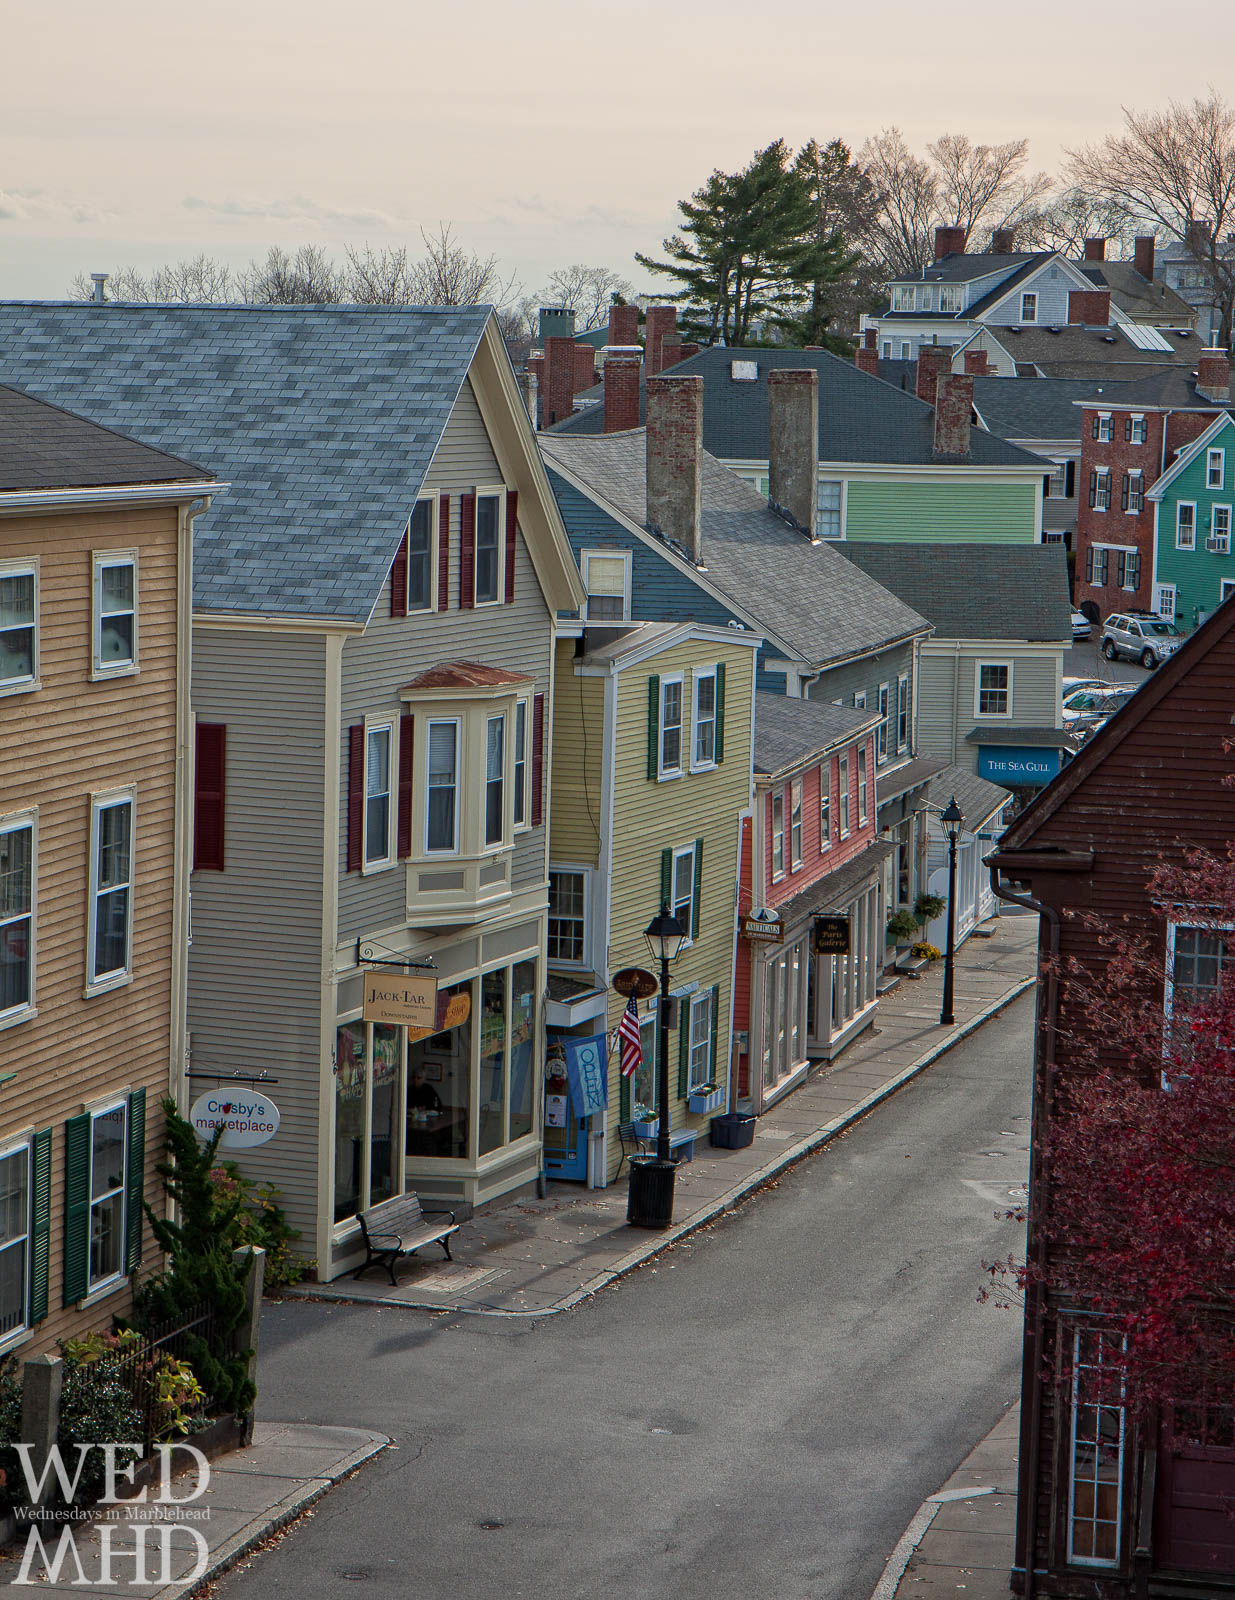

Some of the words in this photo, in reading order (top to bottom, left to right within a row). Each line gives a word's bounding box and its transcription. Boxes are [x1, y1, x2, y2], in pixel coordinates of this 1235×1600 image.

[988, 760, 1006, 770] THE
[1008, 761, 1025, 771] SEA
[1026, 762, 1050, 772] GULL
[747, 922, 779, 933] NAUTICALS
[368, 989, 425, 1004] JACK-TAR
[581, 1049, 600, 1109] OPEN
[195, 1118, 274, 1133] marketplace
